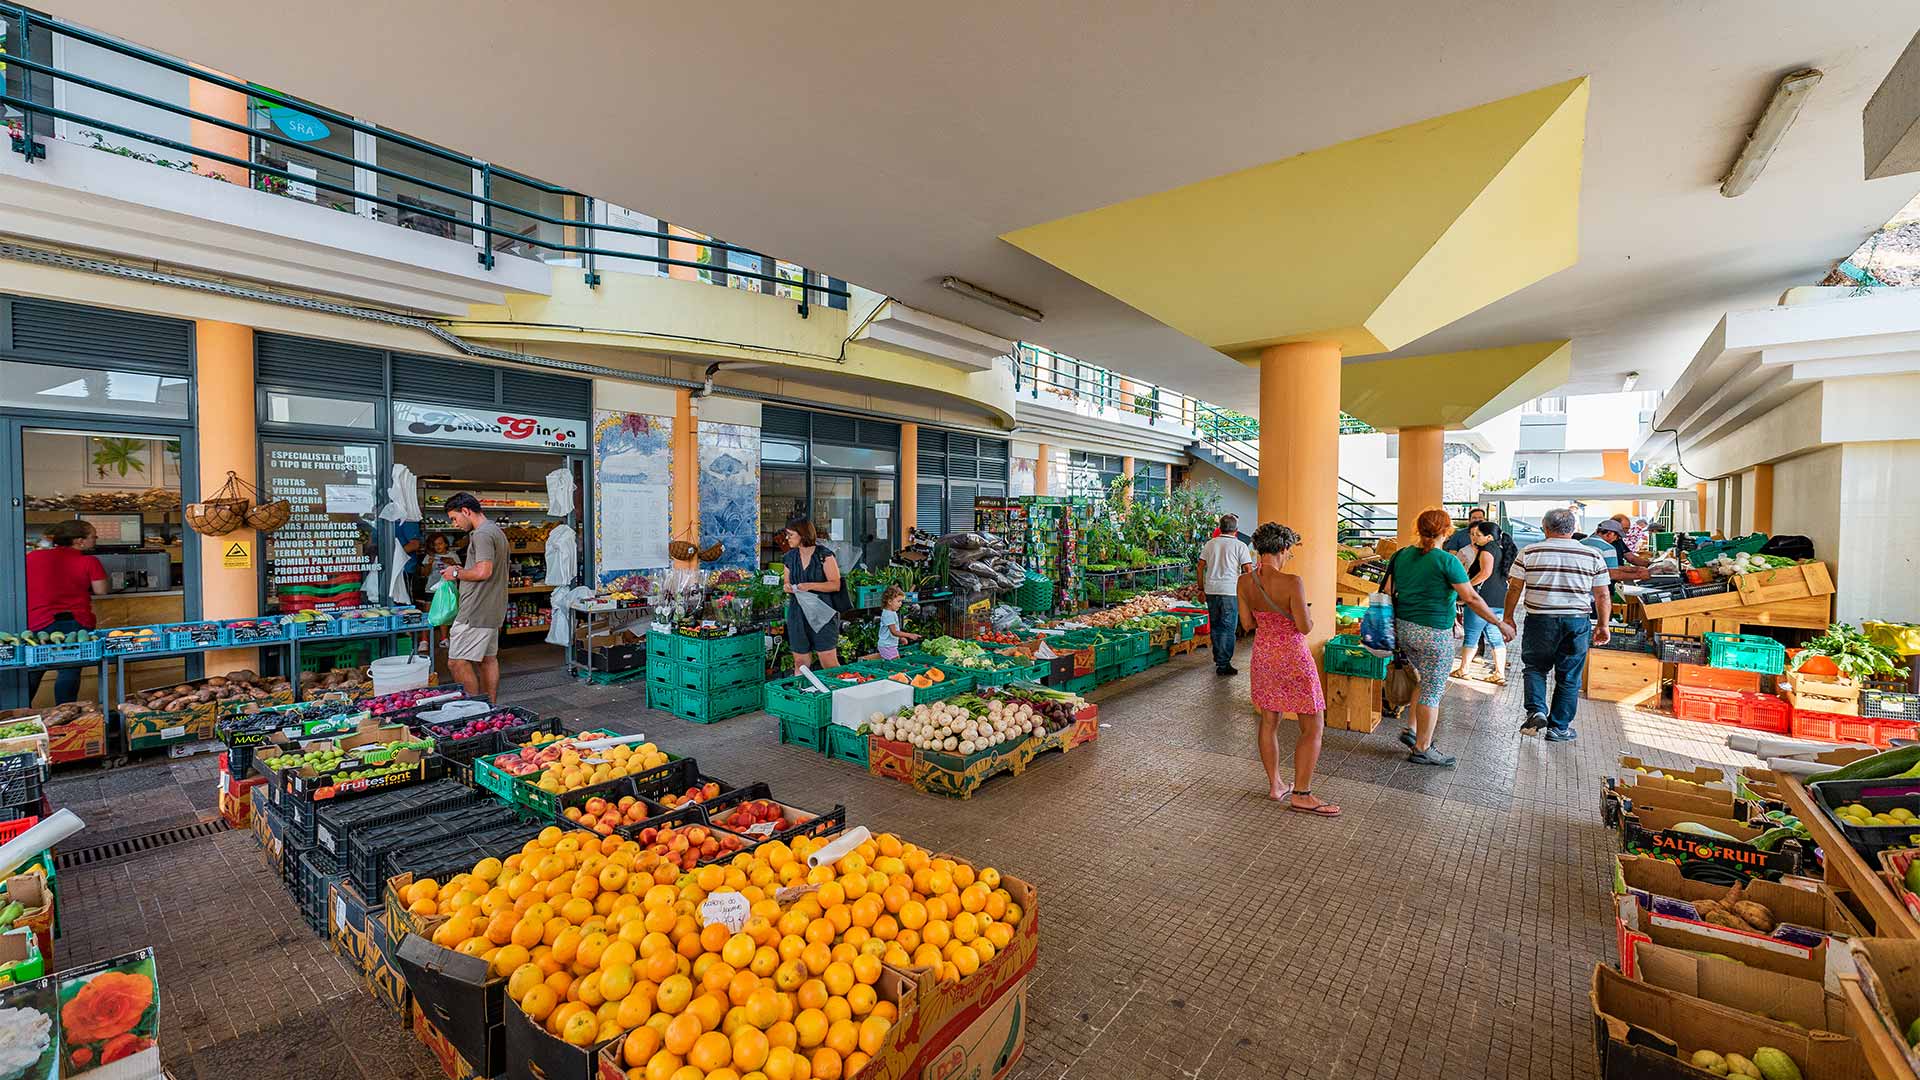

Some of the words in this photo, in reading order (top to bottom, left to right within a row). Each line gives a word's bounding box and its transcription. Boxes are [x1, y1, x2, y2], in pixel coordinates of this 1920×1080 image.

[289, 120, 315, 137] SRA
[271, 451, 331, 462] ESPECIALISTA
[333, 454, 345, 462] EM
[280, 460, 299, 469] TIPO
[302, 461, 313, 470] DE
[314, 462, 346, 471] FRUTOS
[272, 477, 306, 486] FRUTAS
[272, 487, 319, 496] VERDURAS
[290, 504, 310, 513] EAIS
[303, 521, 358, 531] AROMÁTICAS
[273, 531, 312, 540] PLANTAS
[313, 529, 361, 539] AGRÍCOLAS
[315, 539, 327, 548] DE
[328, 539, 355, 547] FRUTO
[274, 549, 302, 557] TERRA
[304, 548, 326, 556] PARA
[328, 547, 358, 556] FLORES
[274, 557, 310, 567] COMIDA
[312, 556, 334, 565] PARA
[335, 555, 370, 564] ANIMAIS
[274, 565, 322, 575] PRODUTOS
[323, 563, 383, 573] VENEZUELANOS
[274, 574, 329, 584] GARRAFEIRA
[340, 771, 412, 792] fruitesfont
